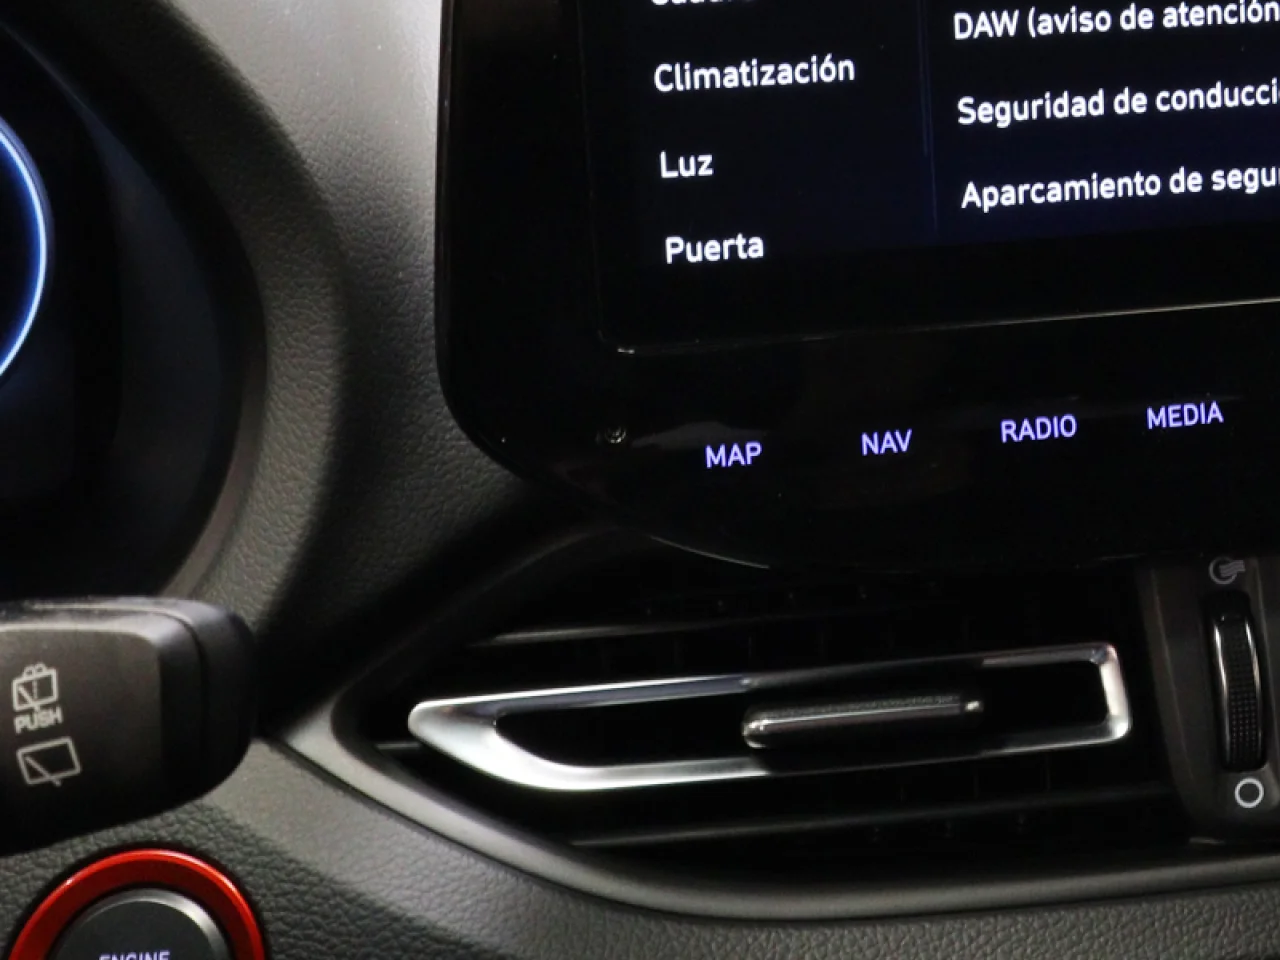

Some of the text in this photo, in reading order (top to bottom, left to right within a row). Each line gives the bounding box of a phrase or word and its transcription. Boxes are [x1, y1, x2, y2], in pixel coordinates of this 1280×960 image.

[953, 9, 1020, 41] DAW
[1027, 5, 1114, 38] (aviso
[1119, 2, 1155, 32] de
[653, 53, 856, 93] Climatización
[957, 87, 1105, 129] Seguridad
[1113, 86, 1149, 115] de
[660, 151, 714, 179] Luz
[961, 172, 1162, 213] Aparcamiento
[1168, 165, 1204, 195] de
[665, 233, 765, 265] Puerta
[1000, 413, 1079, 444] RADIO
[1146, 400, 1225, 431] MEDIA
[704, 440, 764, 470] MAP
[861, 428, 914, 456] NAV
[13, 707, 63, 733] PUSH
